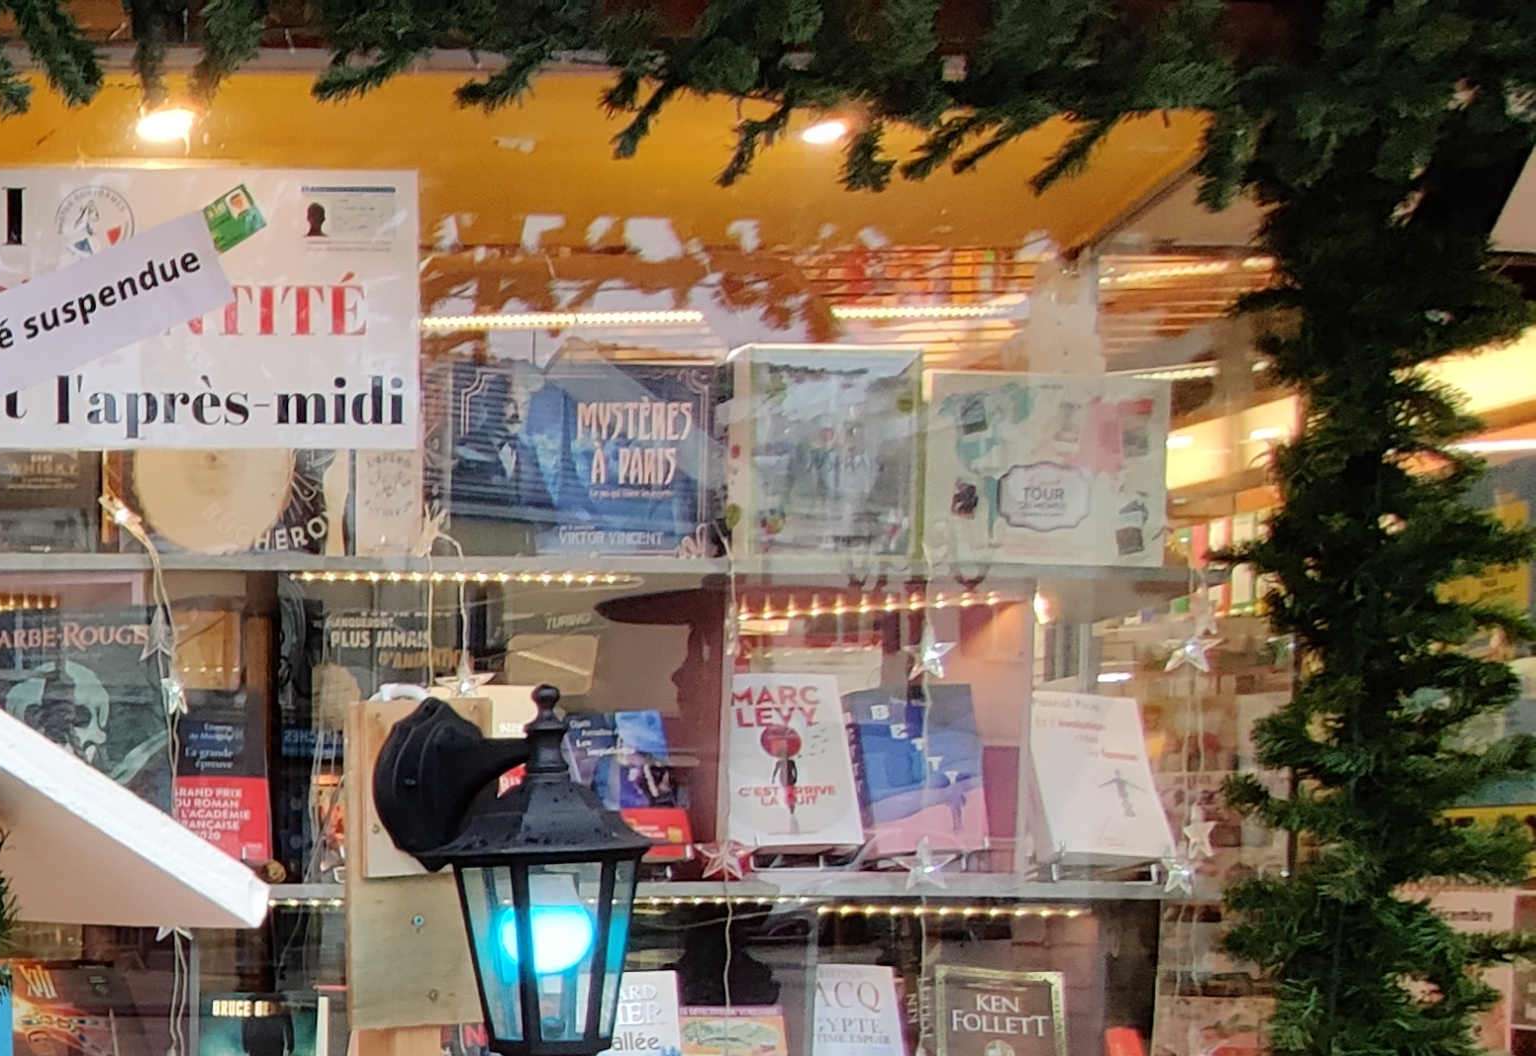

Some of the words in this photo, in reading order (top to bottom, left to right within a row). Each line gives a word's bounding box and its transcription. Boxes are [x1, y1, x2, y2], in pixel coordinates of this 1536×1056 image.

[22, 249, 203, 341] suspendue
[54, 374, 407, 440] l'après-midi
[577, 396, 693, 441] MYSTÈRES
[7, 462, 78, 475] WHISKY
[590, 441, 607, 486] À
[618, 447, 677, 486] PARIS
[1021, 487, 1065, 501] TOUR
[559, 531, 604, 545] VIKTOR
[608, 531, 664, 546] VINCENT
[330, 630, 371, 648] PLUS
[731, 685, 821, 706] MARC
[736, 706, 818, 728] LEVY
[199, 747, 234, 761] grande
[195, 759, 234, 771] épreuve
[214, 788, 243, 798] PRIX
[738, 786, 778, 798] C'EST
[193, 798, 240, 809] ROMAN
[760, 796, 778, 806] LA
[180, 807, 251, 821] L'ACADÉMIE
[815, 979, 882, 1013] ACQ
[976, 993, 1020, 1013] KEN
[212, 1000, 252, 1017] BRUCE
[951, 1008, 1050, 1037] FOLLETT
[849, 1034, 891, 1045] ESPOIR
